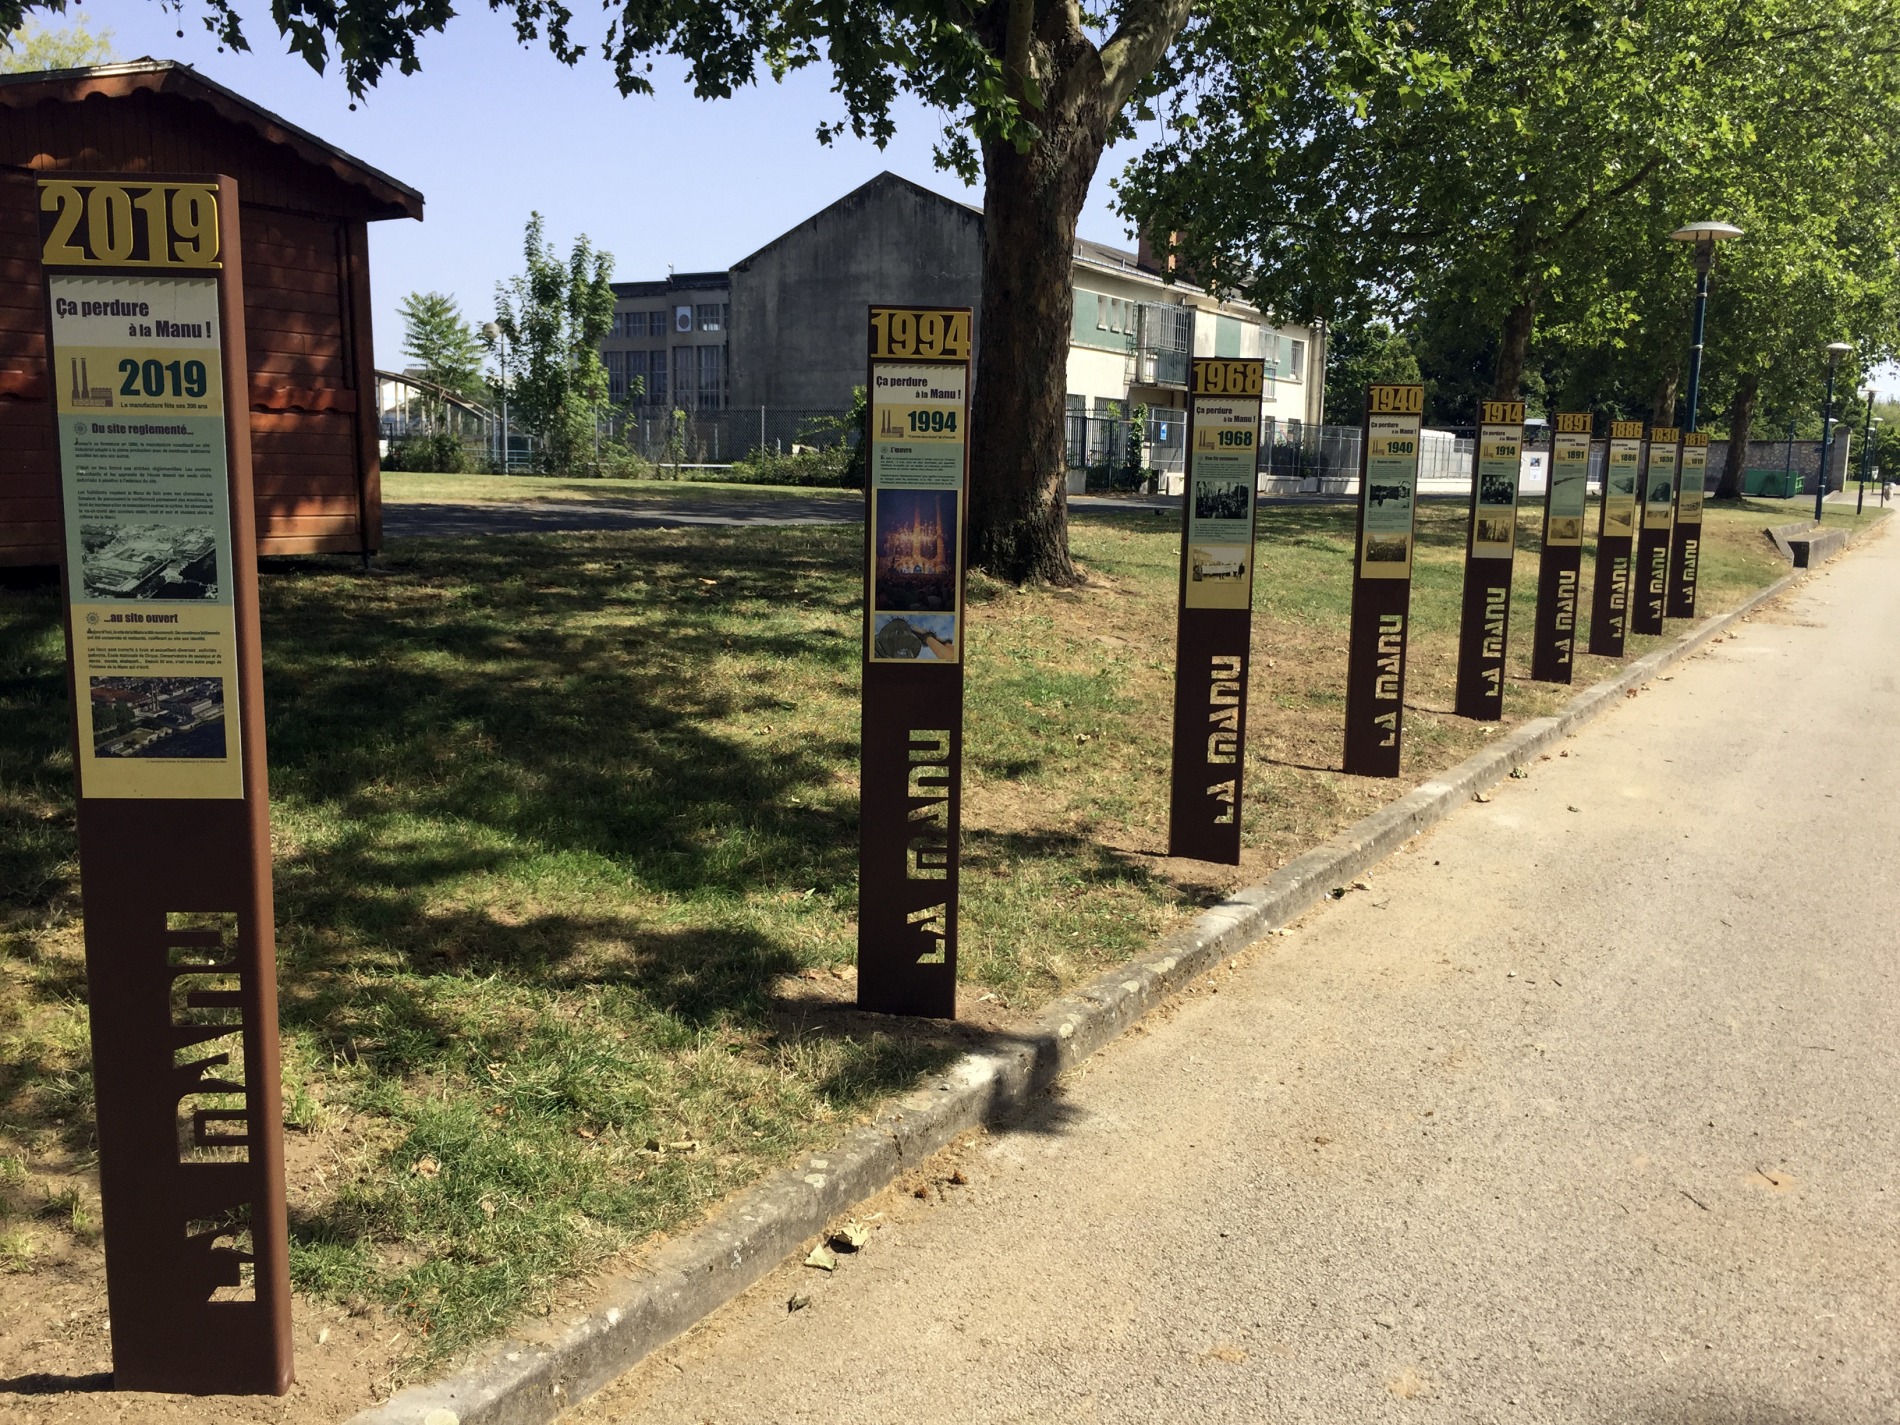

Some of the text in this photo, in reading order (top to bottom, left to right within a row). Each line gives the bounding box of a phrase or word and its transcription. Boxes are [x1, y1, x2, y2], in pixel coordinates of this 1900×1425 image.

[39, 181, 221, 267] 2019
[56, 298, 149, 318] Ça perdure
[129, 323, 137, 337] à
[139, 323, 152, 337] la
[155, 320, 202, 338] Manu
[871, 310, 970, 359] 1994
[119, 358, 207, 398] 2019
[876, 376, 928, 388] Ça perdure
[1193, 361, 1263, 394] 1968
[915, 390, 920, 398] à
[921, 391, 928, 399] la
[930, 389, 956, 399] Manu
[1369, 386, 1423, 412] 1940
[908, 410, 957, 432] 1994
[1196, 406, 1232, 415] Ça perdure
[1481, 402, 1524, 423] 1914
[92, 423, 105, 434] Du
[107, 423, 126, 434] site
[1556, 414, 1593, 432] 1891
[1610, 422, 1643, 438] 1886
[1217, 430, 1252, 446] 1968
[1651, 427, 1679, 442] 1830
[1684, 433, 1708, 447] 1819
[1387, 442, 1413, 453] 1940
[1496, 446, 1515, 456] 1914
[1567, 451, 1584, 459] 1891
[1682, 540, 1697, 603] LA MANU
[1649, 547, 1666, 618] LA MANU
[1609, 558, 1627, 638] LA MANU
[125, 613, 144, 623] site
[146, 613, 178, 623] ouvert
[1555, 570, 1576, 663] LA MANU
[1482, 588, 1506, 696] LA MANU
[1374, 614, 1402, 746] LA MANU
[1207, 656, 1241, 823] LA MANU
[907, 730, 950, 963] LA MANU
[166, 912, 256, 1302] LA MANU
